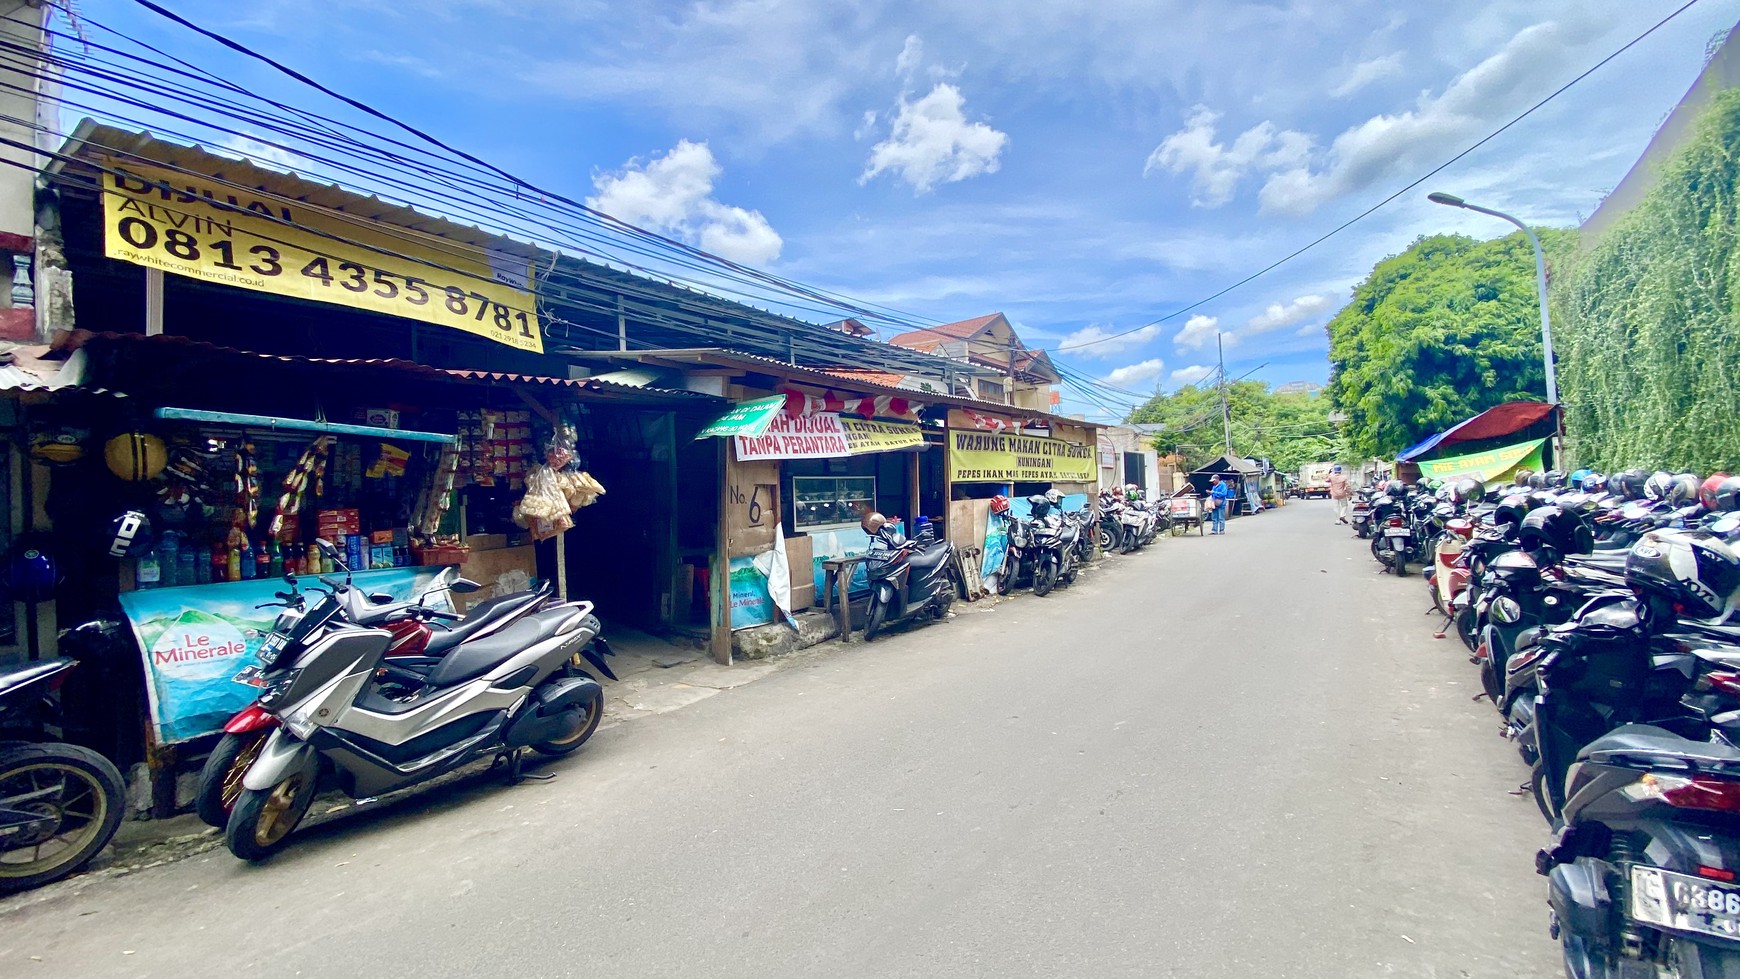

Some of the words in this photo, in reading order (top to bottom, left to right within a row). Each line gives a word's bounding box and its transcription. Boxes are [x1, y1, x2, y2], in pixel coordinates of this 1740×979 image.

[118, 198, 232, 237] ALVIN
[118, 216, 283, 277] 0813
[300, 256, 429, 306] 4355
[445, 285, 535, 340] 8781
[794, 414, 841, 434] DIJUAL
[852, 422, 886, 434] CITRA
[739, 434, 782, 456] TANPA
[783, 434, 847, 455] PERANTARA
[956, 433, 1006, 452] WARUNG
[1009, 437, 1041, 455] MAKAN
[1042, 441, 1066, 457] CITRA
[957, 469, 981, 479] PEPES
[983, 469, 1004, 478] IKAN
[1022, 470, 1039, 479] PEPES
[1432, 462, 1456, 474] MIE
[1459, 454, 1496, 470] AYAM
[729, 485, 748, 505] No.
[748, 486, 761, 524] 6
[184, 633, 210, 648] Le
[155, 640, 245, 666] Minerale
